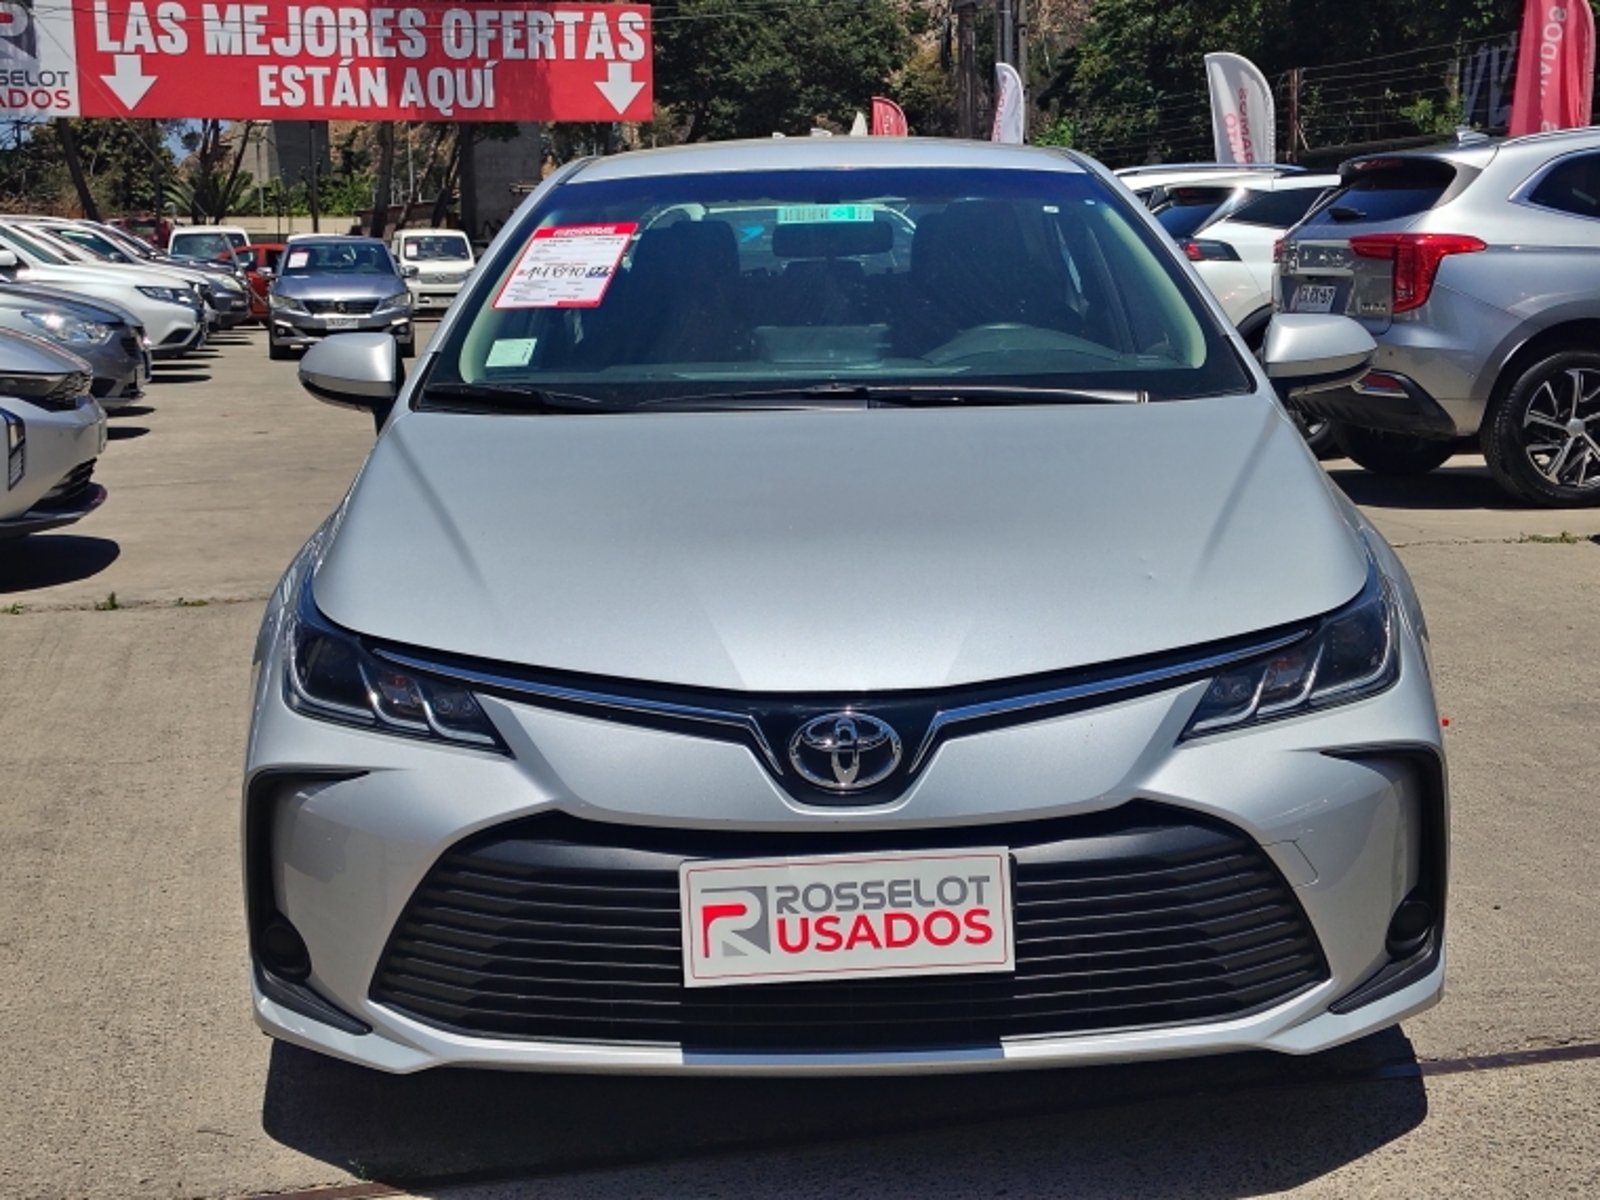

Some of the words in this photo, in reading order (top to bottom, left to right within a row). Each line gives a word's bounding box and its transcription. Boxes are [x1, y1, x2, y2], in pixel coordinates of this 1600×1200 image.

[94, 0, 188, 55] LAS
[202, 4, 427, 58] MEJORES
[441, 8, 646, 61] OFERTAS
[258, 58, 389, 107] ESTÁN
[399, 61, 498, 116] AQUÍ
[775, 875, 991, 914] ROSSELOT
[776, 908, 993, 954] USADOS
